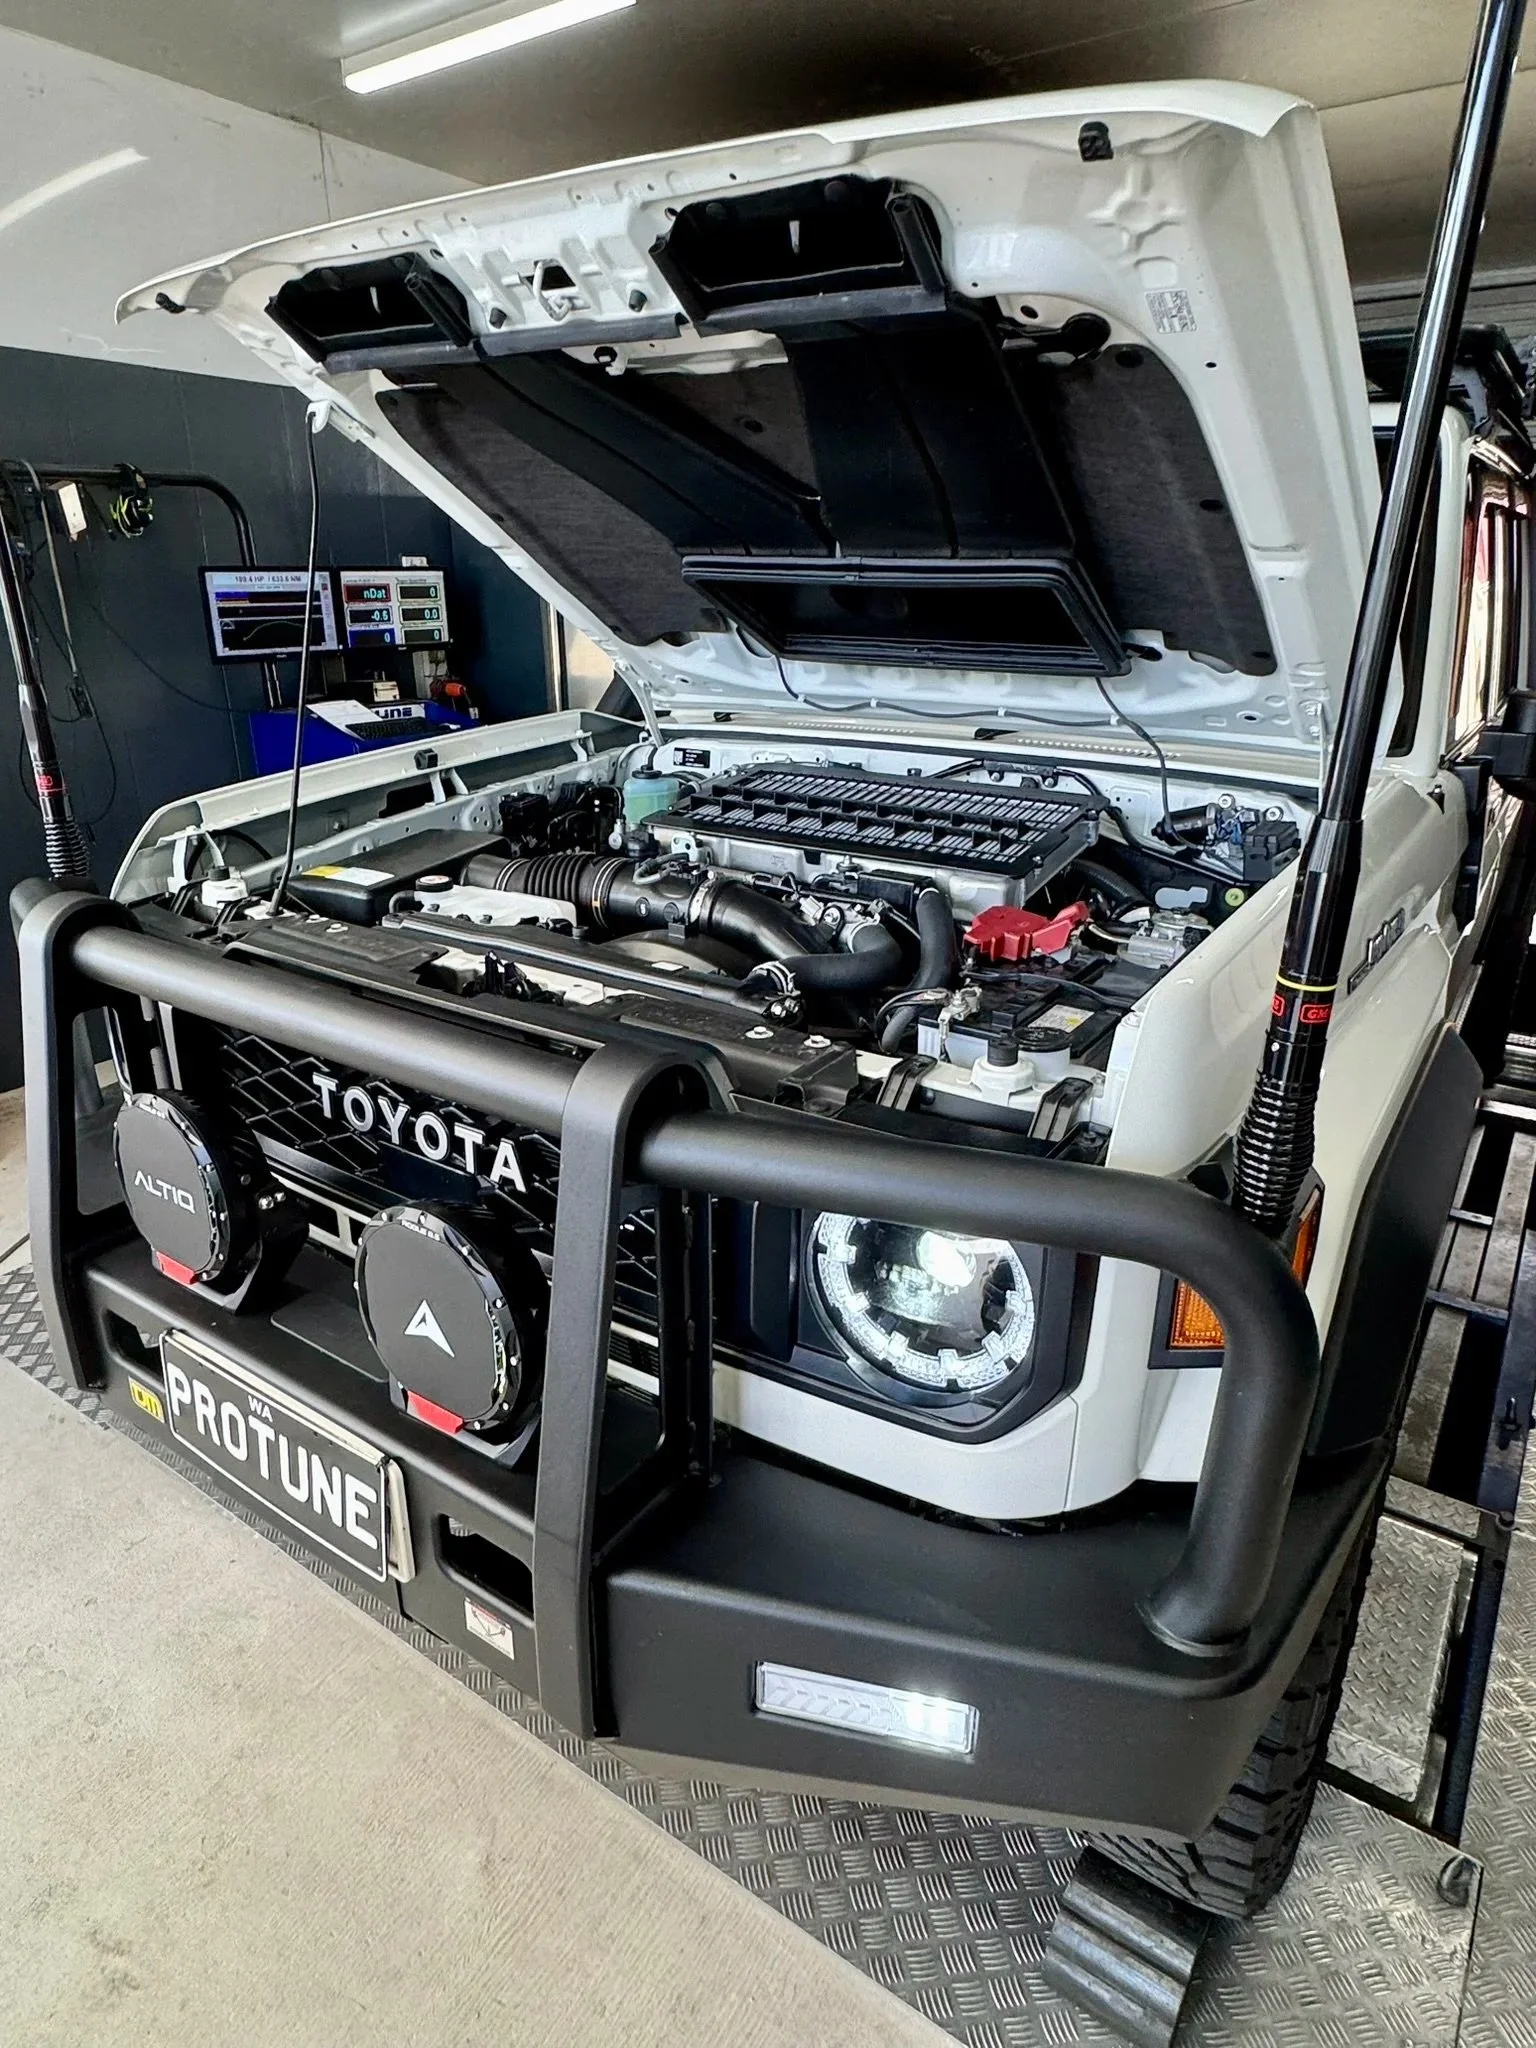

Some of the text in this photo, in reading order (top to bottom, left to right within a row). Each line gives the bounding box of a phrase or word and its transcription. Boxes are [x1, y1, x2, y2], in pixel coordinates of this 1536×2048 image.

[363, 588, 386, 599] nDat
[429, 587, 436, 597] 0
[424, 609, 438, 619] 0.0
[384, 632, 391, 643] 0
[433, 630, 440, 640] 0
[312, 1072, 527, 1193] TOYOTA
[134, 1170, 196, 1214] ALTIQ
[248, 1395, 273, 1422] WA
[167, 1362, 378, 1550] PROTUNE
